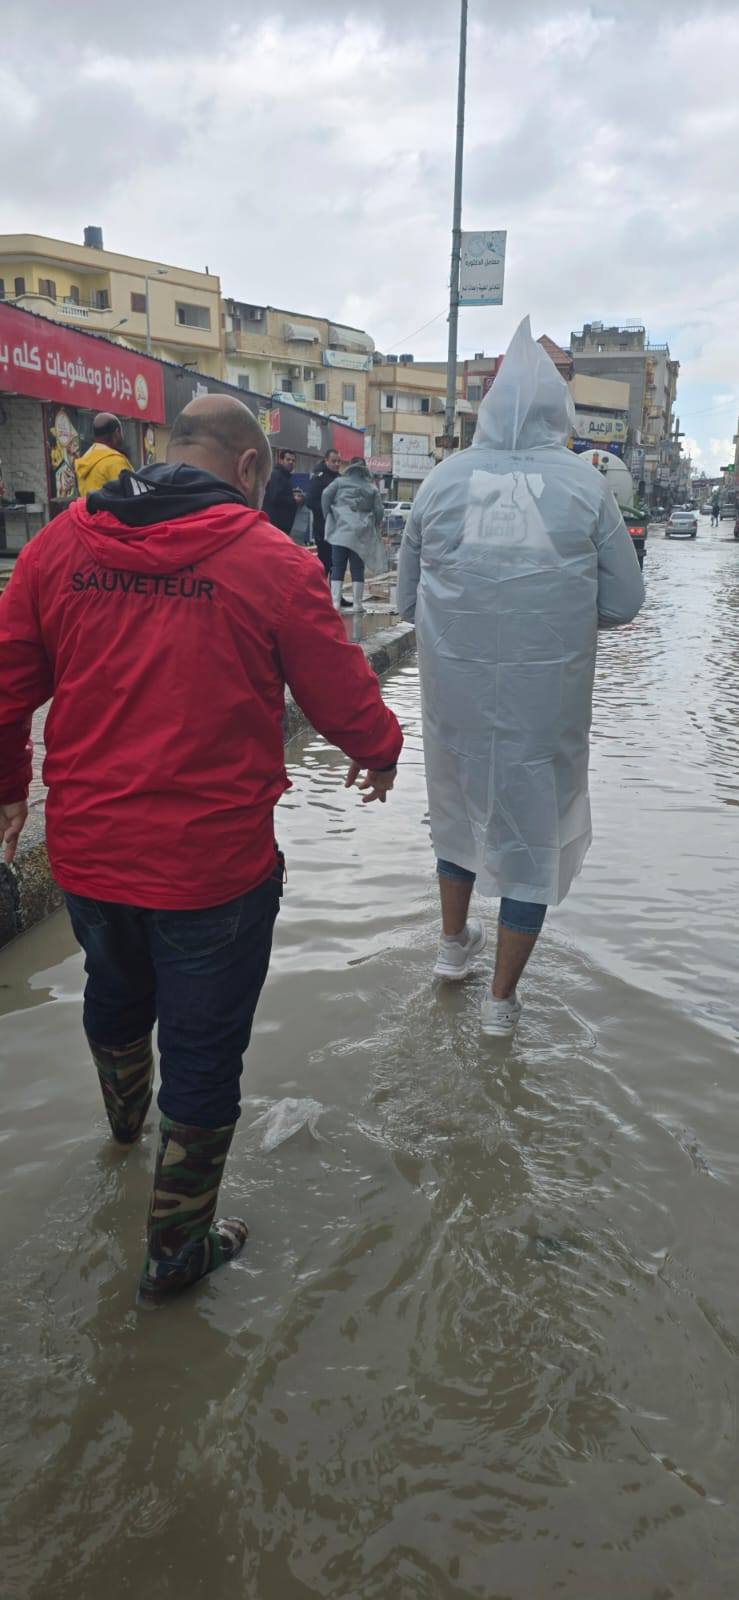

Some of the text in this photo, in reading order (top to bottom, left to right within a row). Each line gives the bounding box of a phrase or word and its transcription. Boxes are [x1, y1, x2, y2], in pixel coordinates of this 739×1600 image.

[13, 341, 42, 371] كله
[45, 351, 102, 395] ومشويات
[104, 365, 133, 401] جزارة
[588, 421, 613, 435] الزعيم
[71, 571, 214, 600] SAUVETEUR
